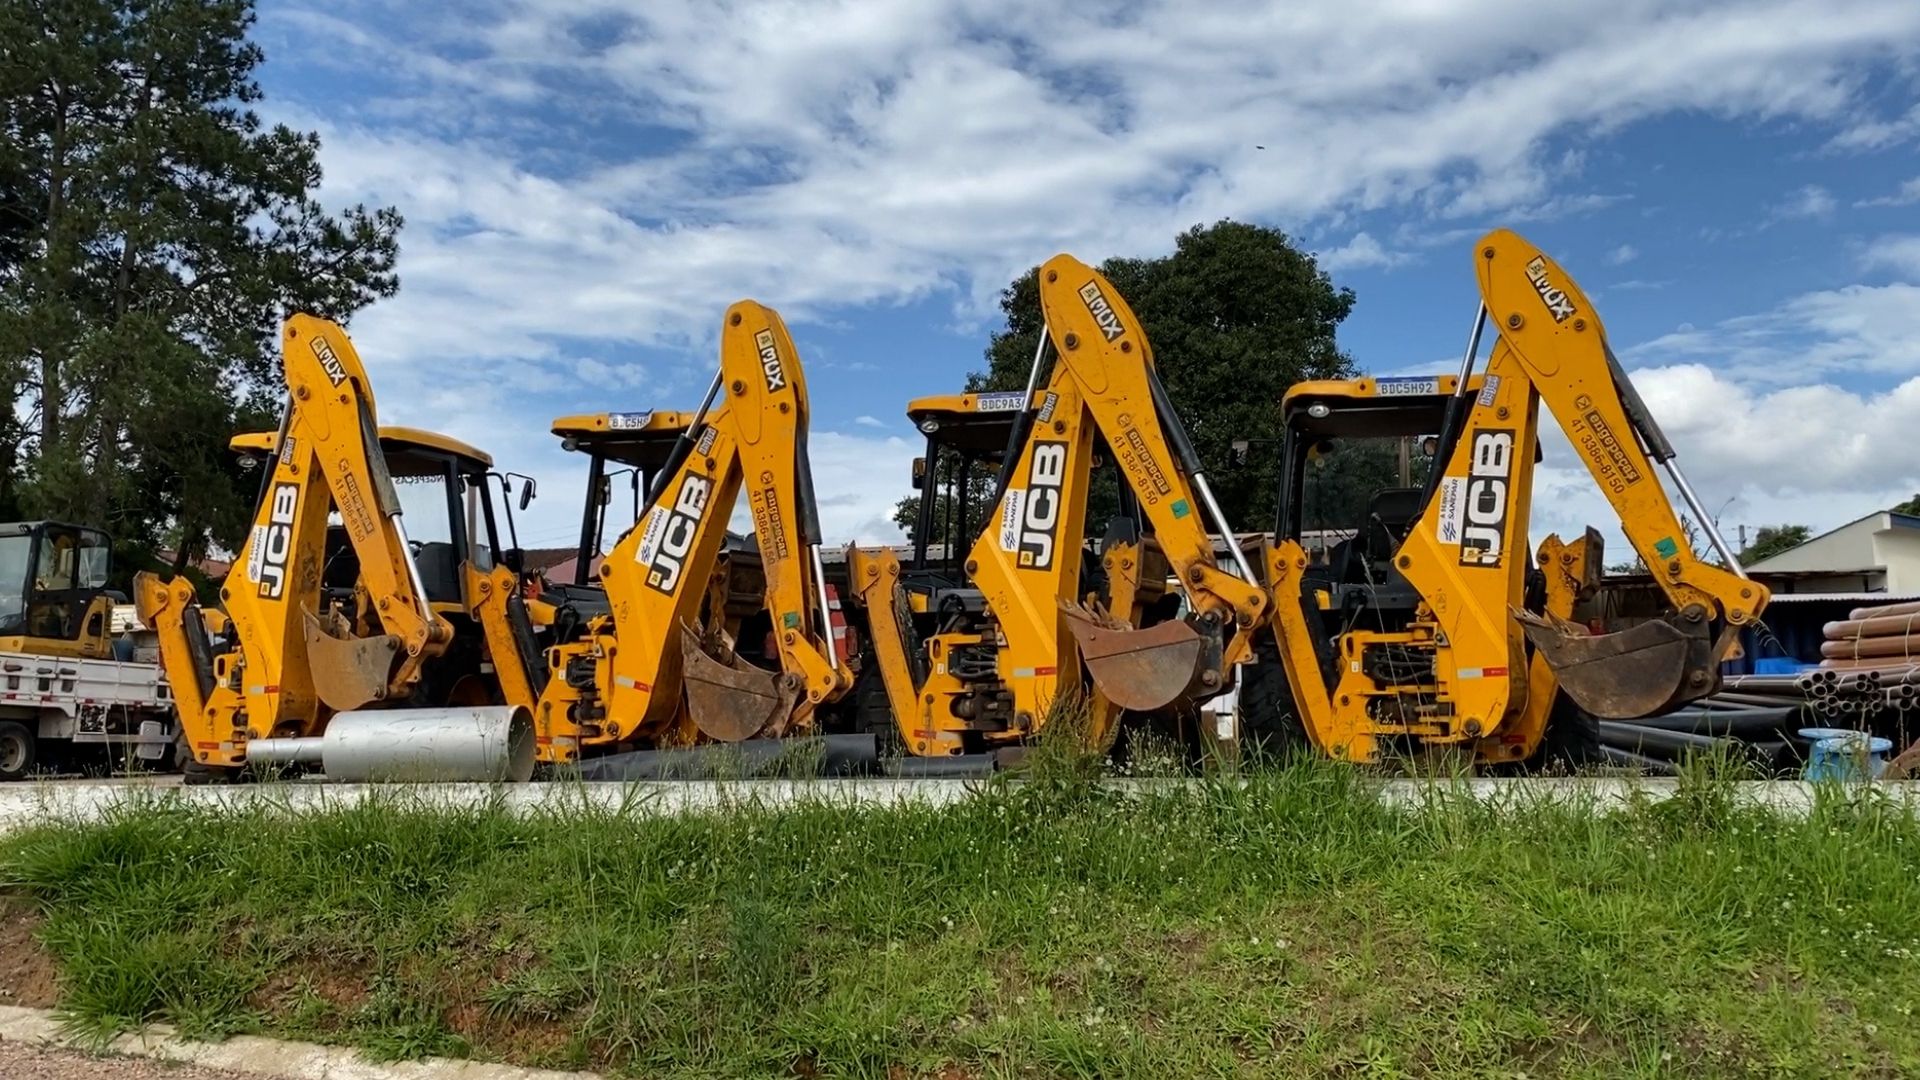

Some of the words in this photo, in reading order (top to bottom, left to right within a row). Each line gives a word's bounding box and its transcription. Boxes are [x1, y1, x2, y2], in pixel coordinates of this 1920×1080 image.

[1089, 296, 1123, 340] 3CX
[318, 346, 348, 386] 3CX
[761, 347, 785, 391] 3CX
[981, 398, 1024, 410] BDC9A3
[1381, 383, 1433, 395] BDC5H92
[612, 416, 649, 428] BC5H
[1113, 436, 1125, 449] 41
[1571, 418, 1585, 433] 41
[1581, 434, 1625, 494] 3386-8150
[752, 490, 762, 503] 41
[1009, 491, 1018, 529] SANEPAR
[1022, 443, 1066, 568] JCB
[1449, 479, 1458, 520] SANEPAR
[1464, 432, 1512, 565] JCB
[262, 485, 299, 597] JCB
[655, 475, 711, 591] JCB
[755, 506, 776, 566] 3386-8150
